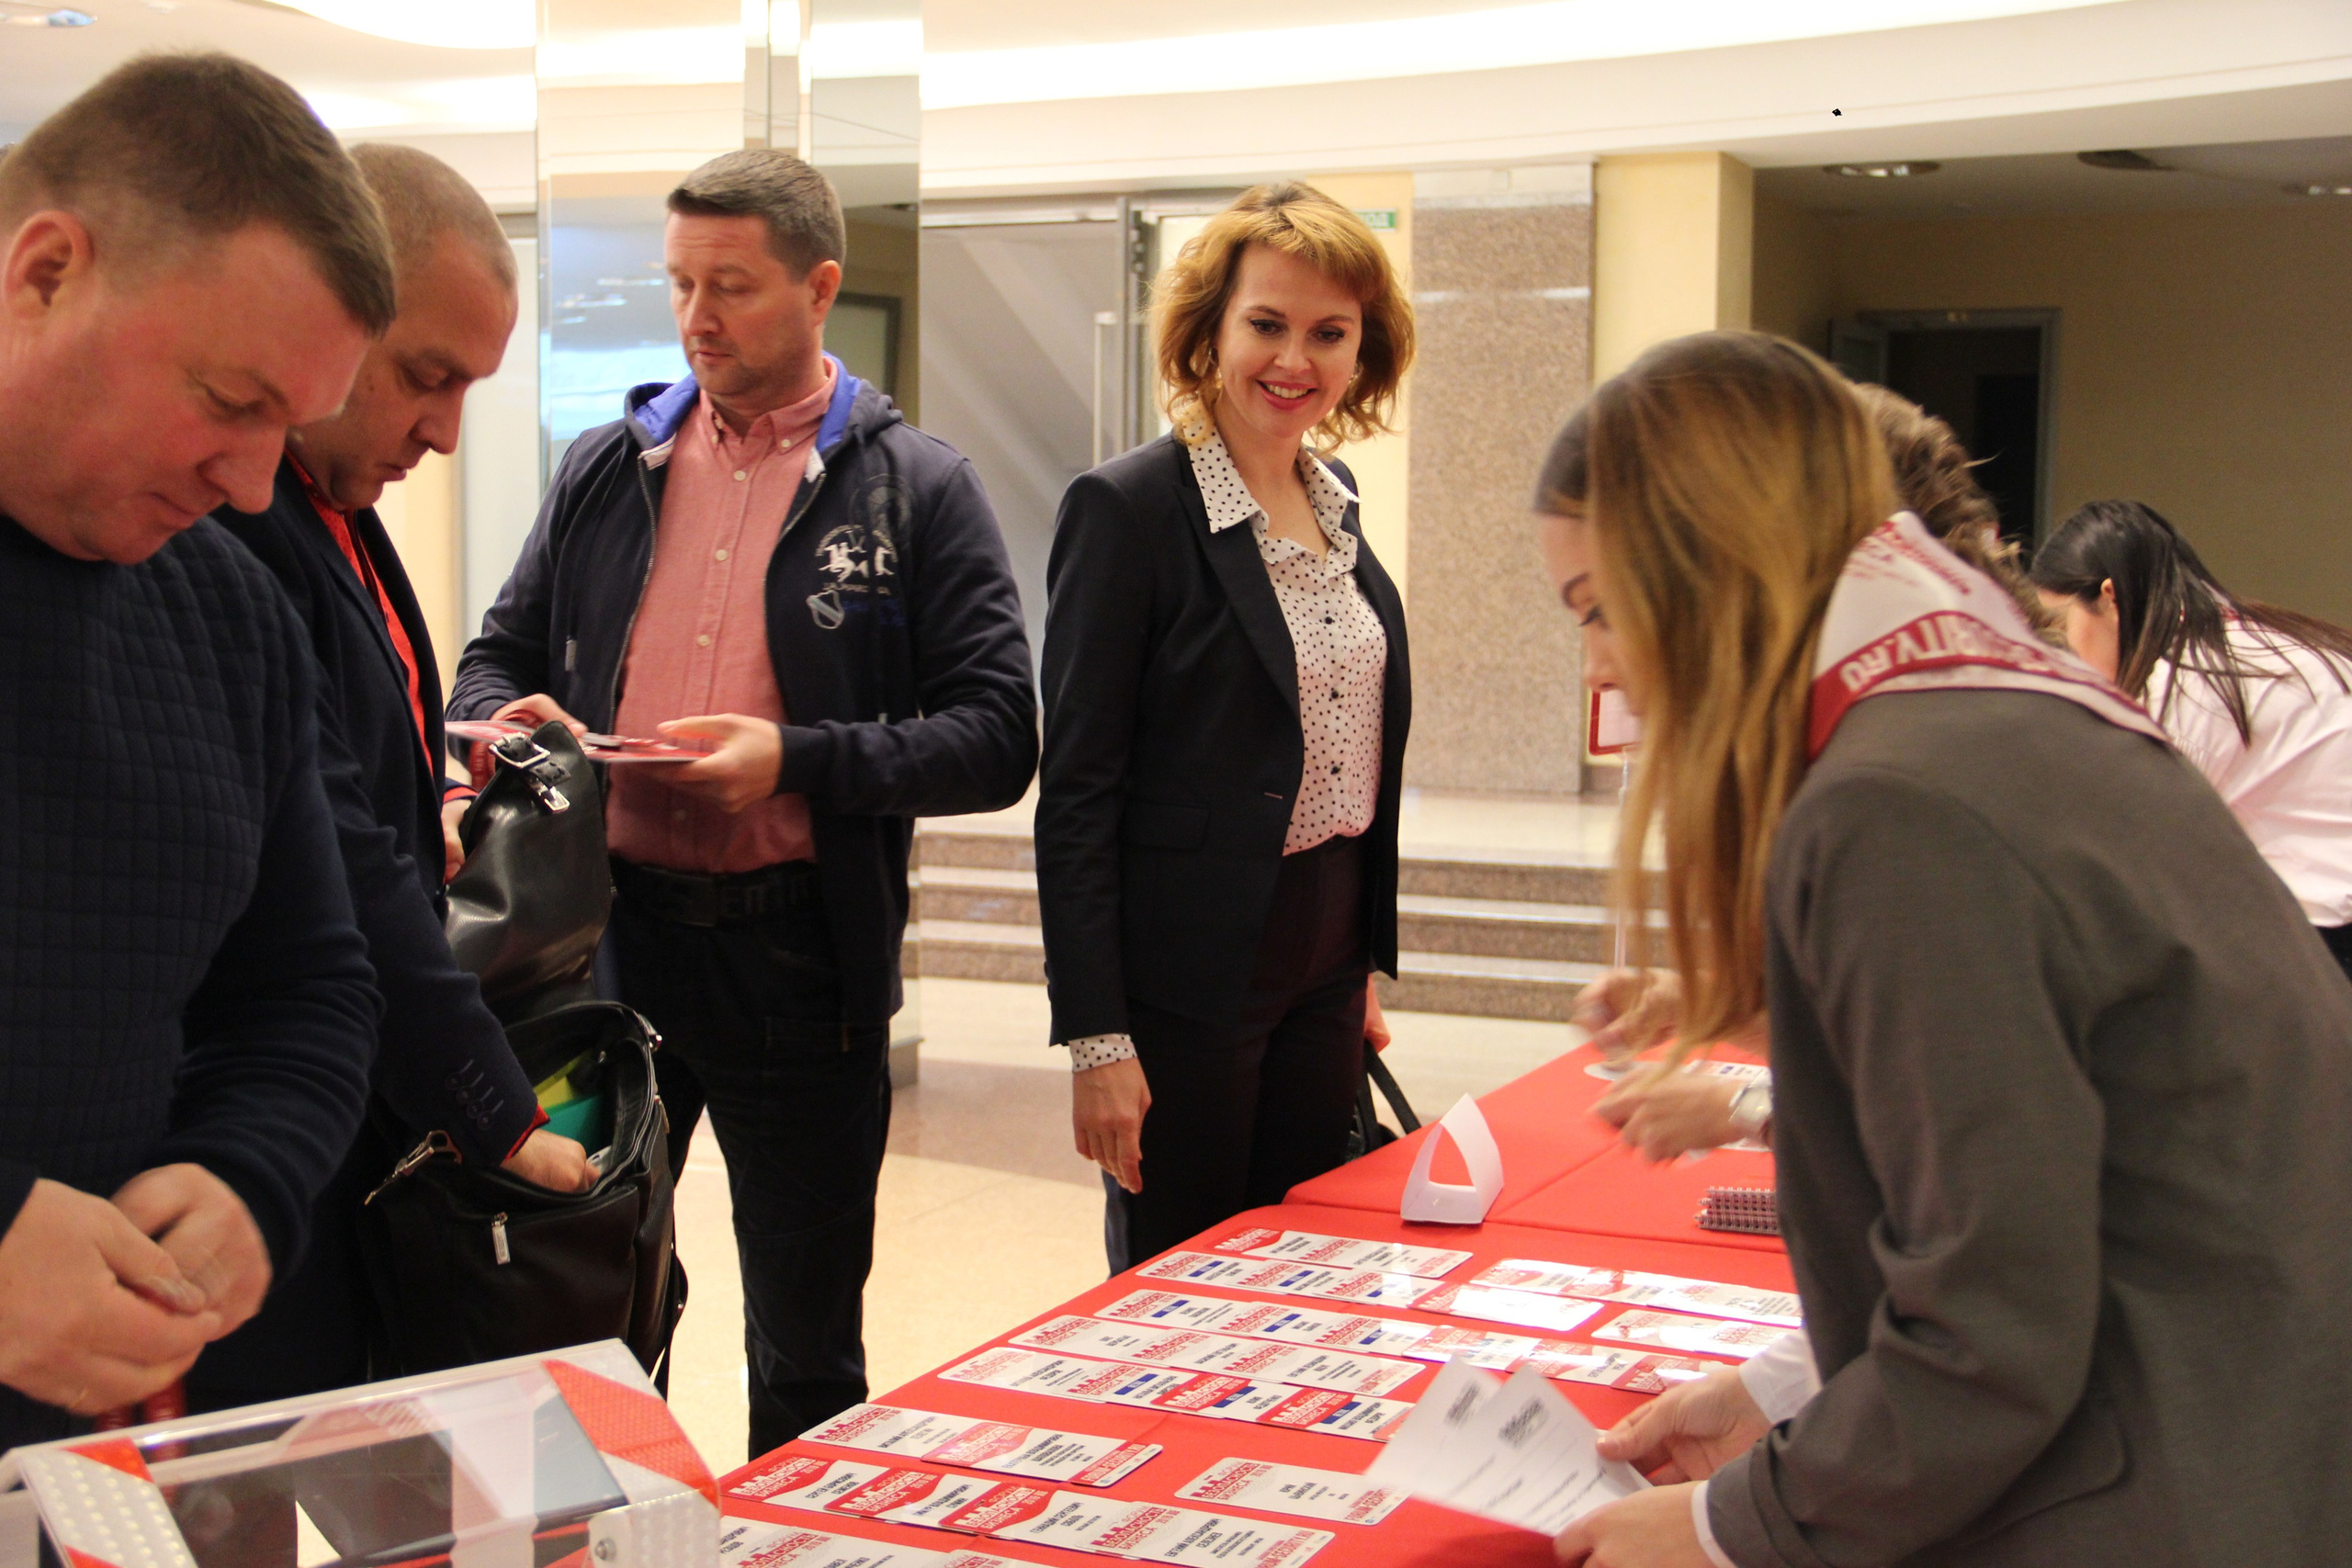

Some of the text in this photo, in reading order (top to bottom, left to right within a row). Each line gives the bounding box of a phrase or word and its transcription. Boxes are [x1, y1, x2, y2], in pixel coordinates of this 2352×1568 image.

[824, 1408, 889, 1439] БЕЗОПАСНОСТЬ
[839, 1424, 876, 1441] БИЗНЕСА
[741, 1458, 816, 1494] БЕЗОПАСНОСТЬ
[754, 1476, 799, 1496] БИЗНЕСА
[1202, 1462, 1259, 1498] БЕЗОПАСНОСТЬ
[851, 1472, 923, 1508] БЕЗОПАСНОСТЬ
[866, 1491, 910, 1511] БИЗНЕСА
[1217, 1480, 1251, 1500] БИЗНЕСА
[966, 1487, 1035, 1526] БЕЗОПАСНОСТЬ
[981, 1507, 1023, 1529] БИЗНЕСА
[1102, 1507, 1166, 1547] БЕЗОПАСНОСТЬ
[1119, 1527, 1157, 1550] БИЗНЕСА
